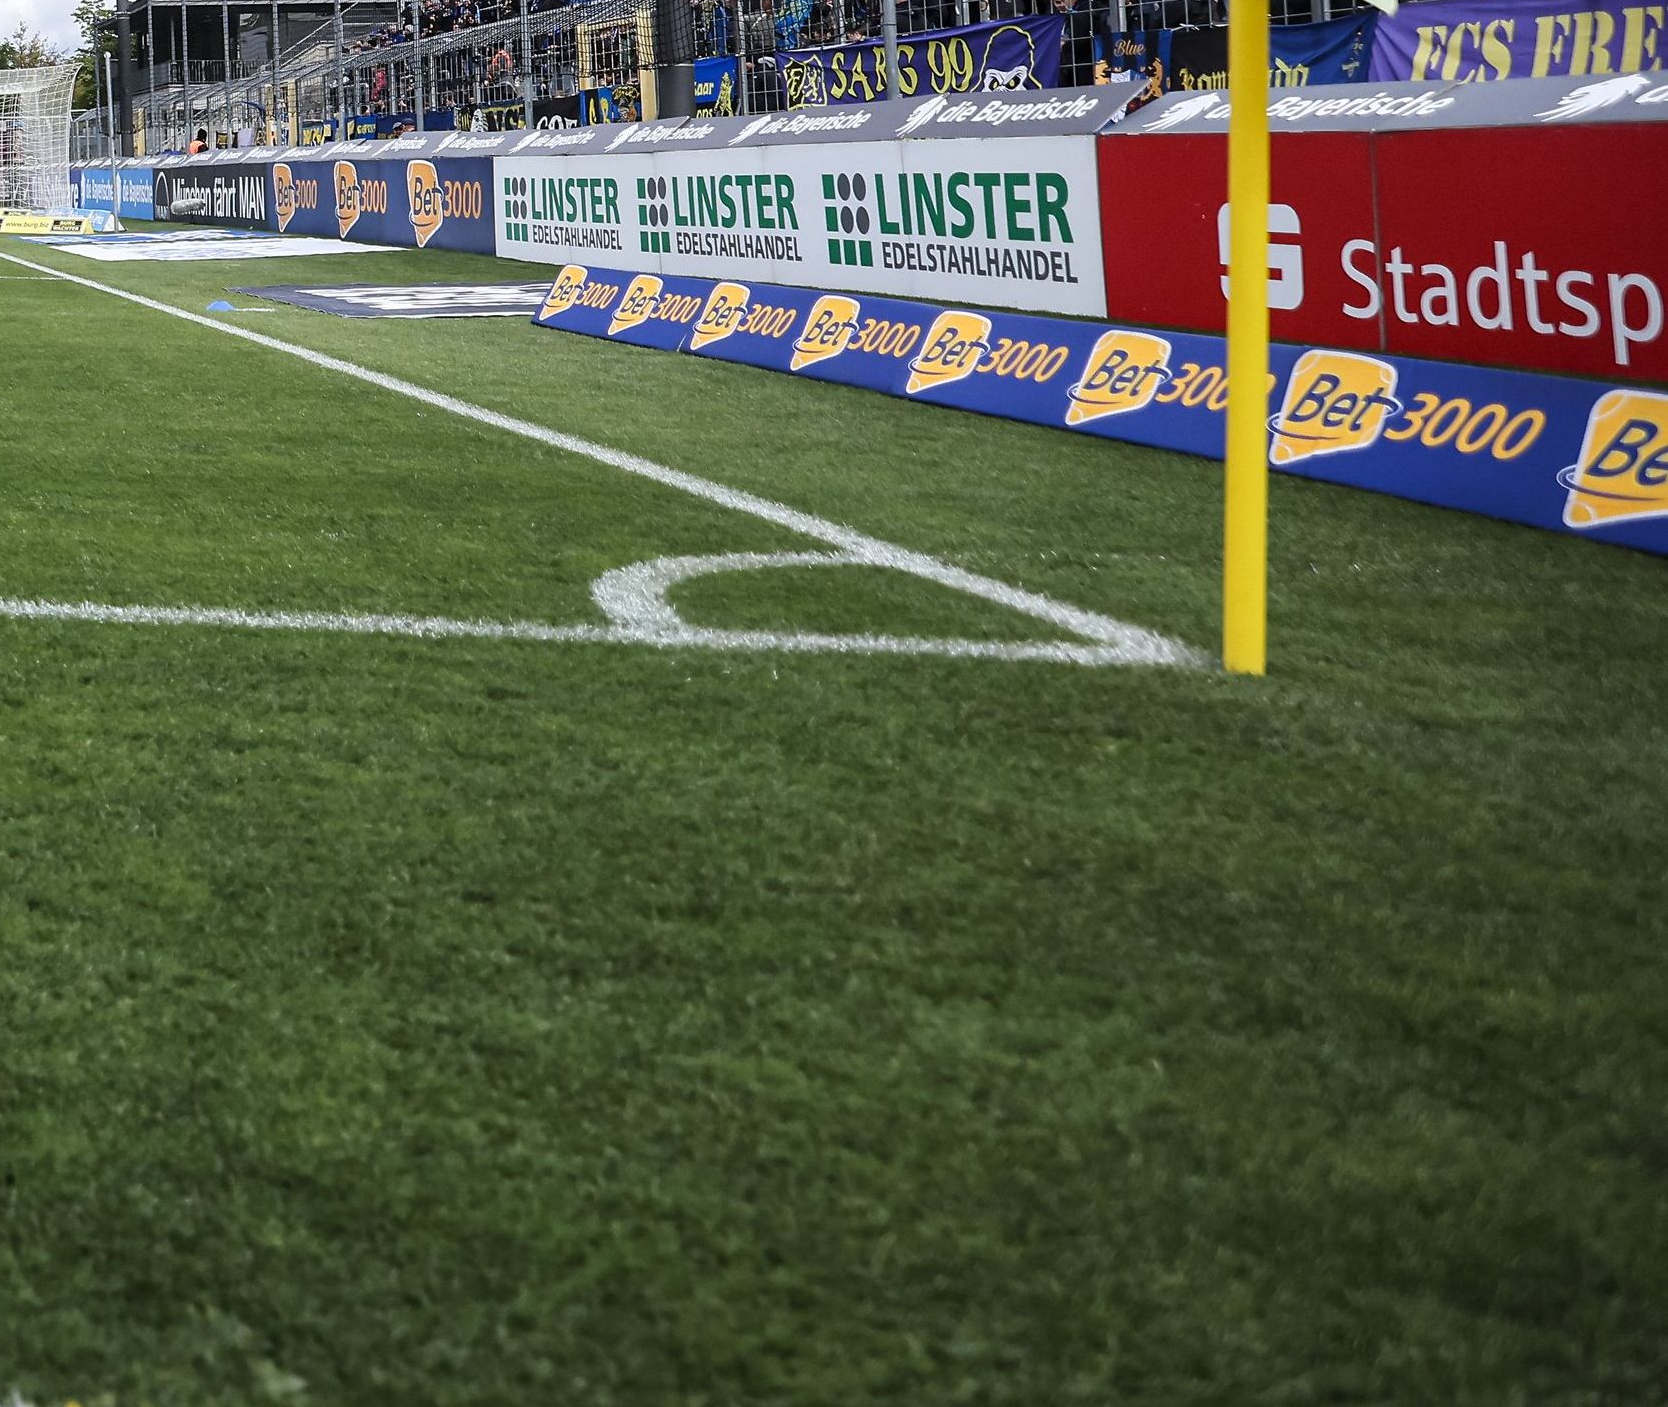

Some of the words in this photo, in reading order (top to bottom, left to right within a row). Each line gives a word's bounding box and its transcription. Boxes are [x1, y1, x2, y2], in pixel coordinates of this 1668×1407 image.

[831, 44, 918, 102] SARG
[927, 38, 974, 94] 99
[1115, 40, 1145, 57] Blue
[758, 117, 788, 135] die
[781, 109, 872, 135] Bayerische
[937, 100, 978, 122] die
[971, 94, 1099, 125] Bayerische
[1267, 91, 1454, 121] Bayerische
[214, 177, 236, 217] fährt
[239, 176, 265, 220] MAN
[530, 177, 621, 224] LINSTER
[672, 174, 799, 230] LINSTER
[875, 171, 1074, 243] LINSTER
[532, 224, 623, 250] EDELSTAHLHANDEL
[677, 231, 802, 262] EDELSTAHLHANDEL
[882, 241, 1078, 284] EDELSTAHLHANDEL
[1340, 239, 1663, 366] Stadtsp
[1154, 361, 1275, 410] 300
